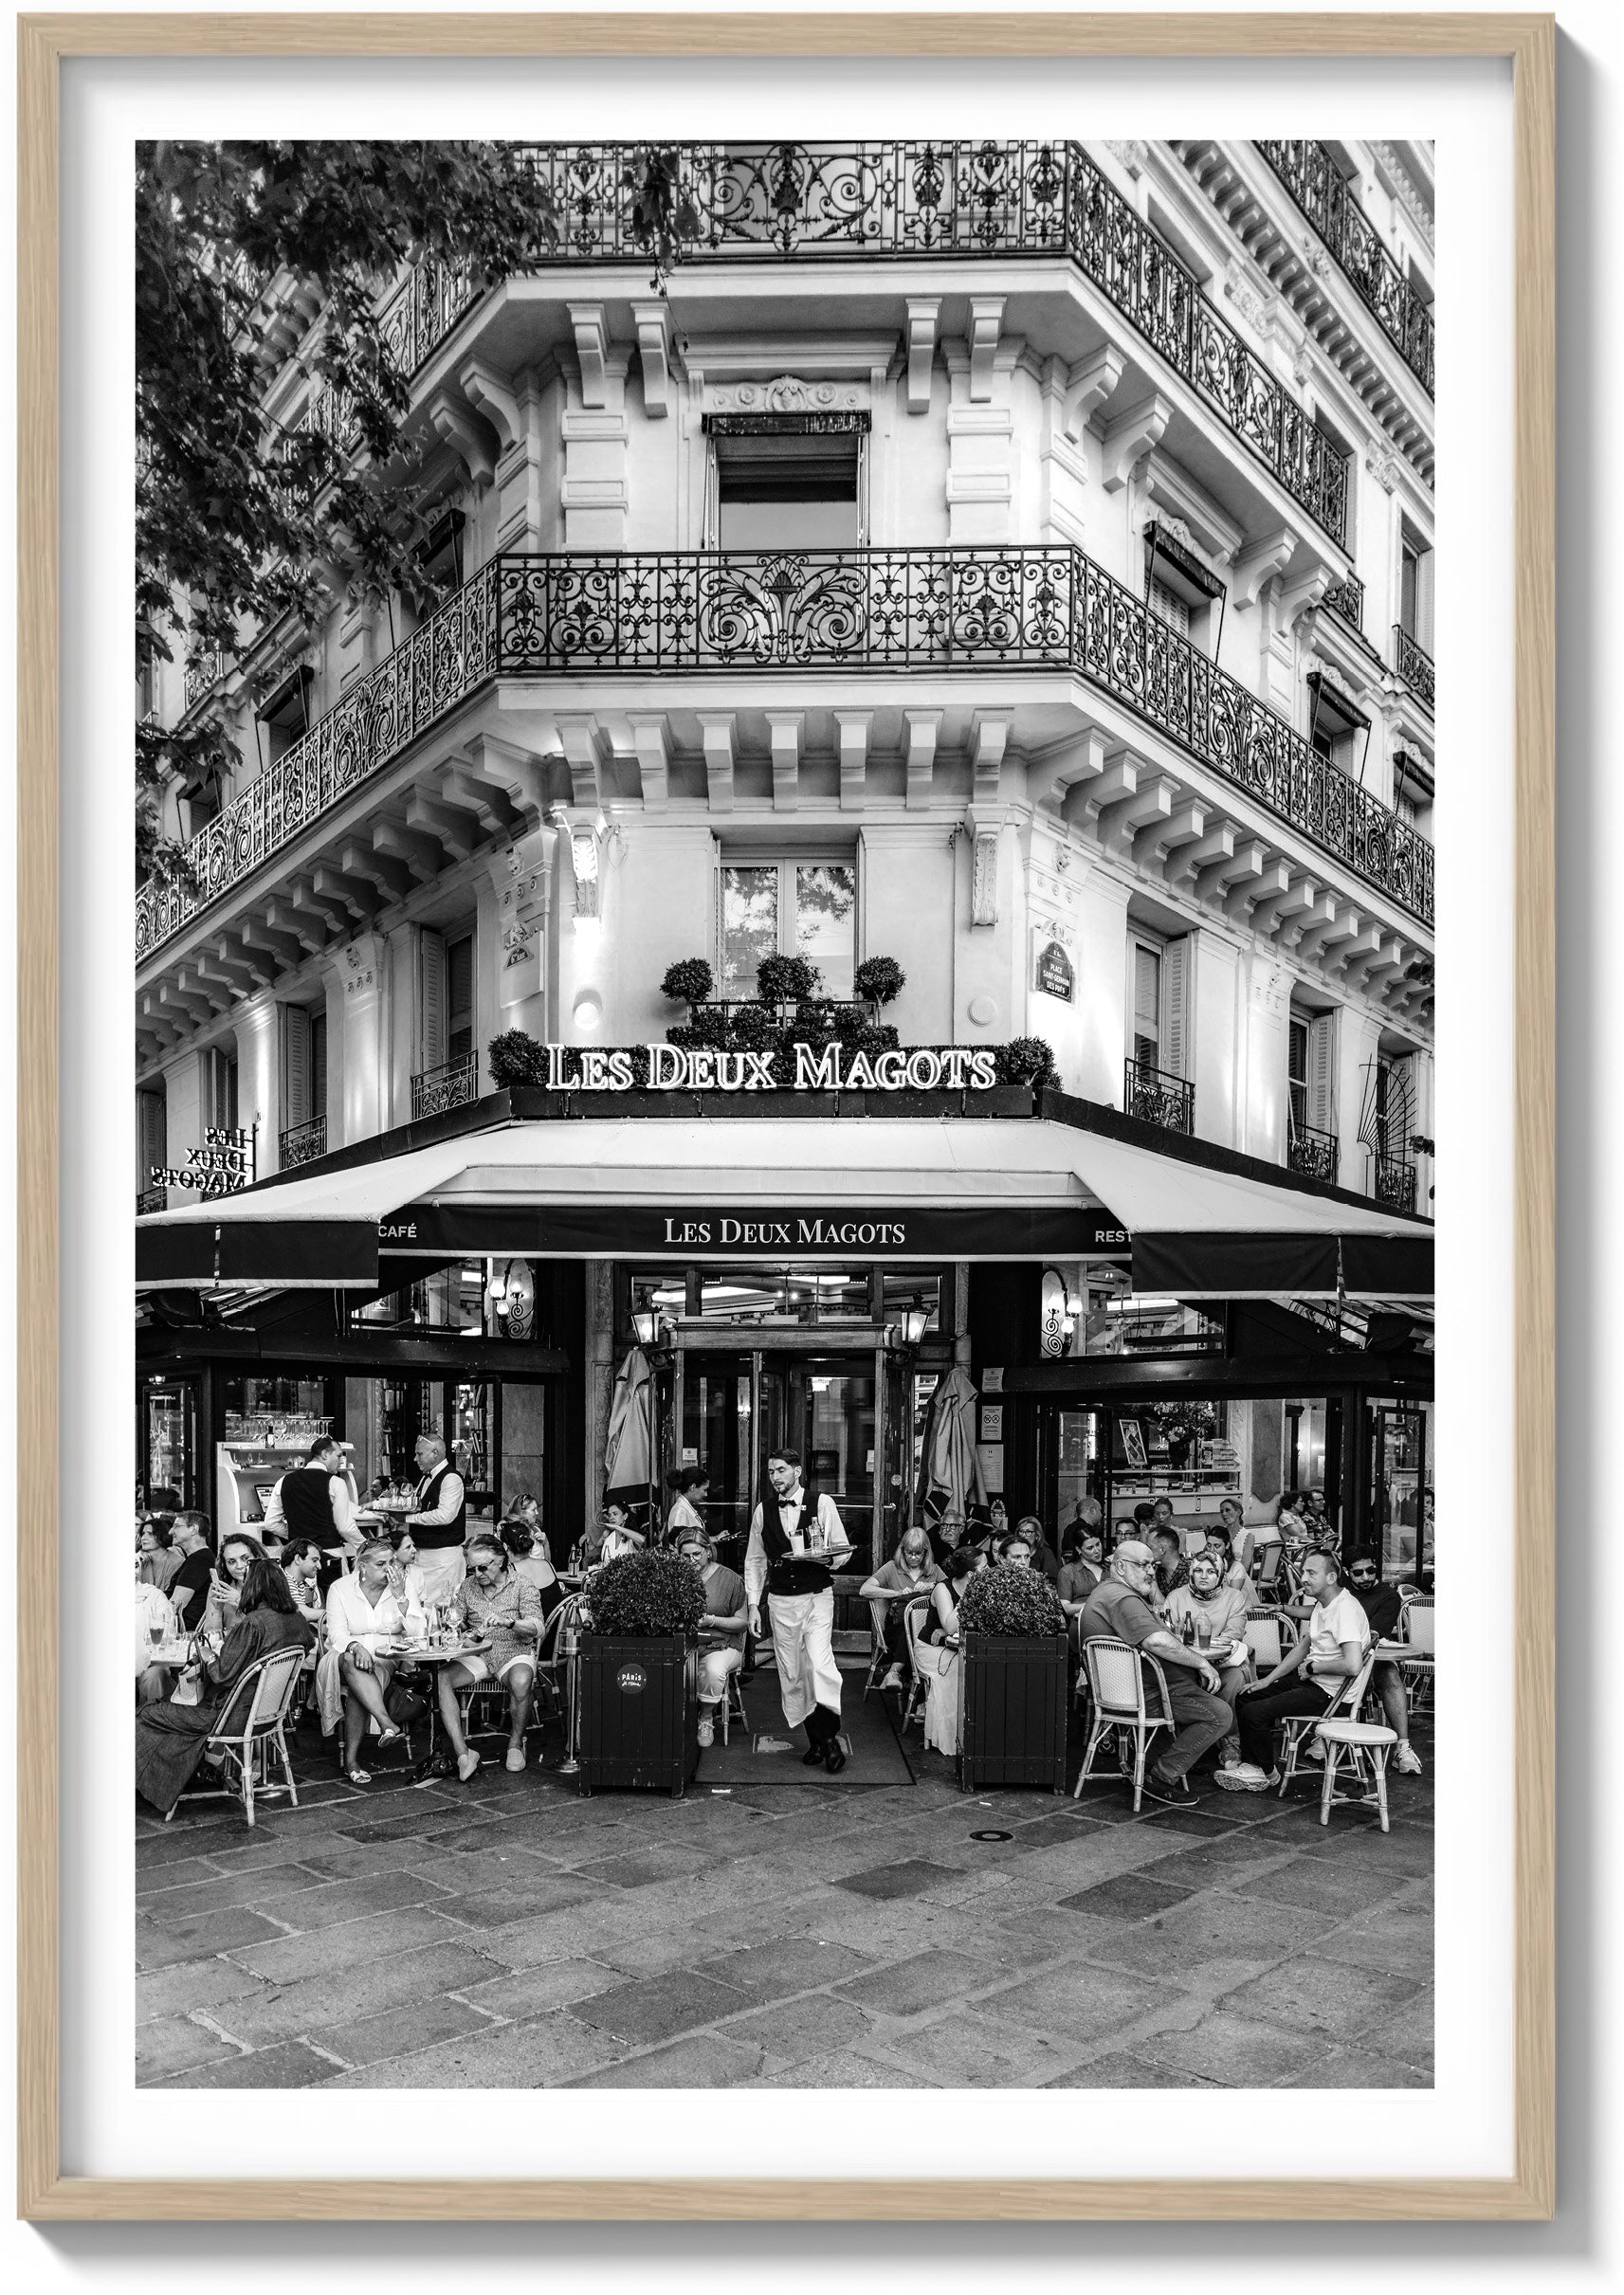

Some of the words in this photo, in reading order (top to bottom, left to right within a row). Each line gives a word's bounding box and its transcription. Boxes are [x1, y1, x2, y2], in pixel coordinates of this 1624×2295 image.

[547, 1043, 633, 1090] LES
[647, 1043, 777, 1089] DEUX
[794, 1043, 996, 1089] MAGOTS
[378, 1223, 417, 1238] CAFÉ
[665, 1218, 711, 1244] LES
[720, 1218, 791, 1244] DEUX
[797, 1219, 905, 1244] MAGOTS
